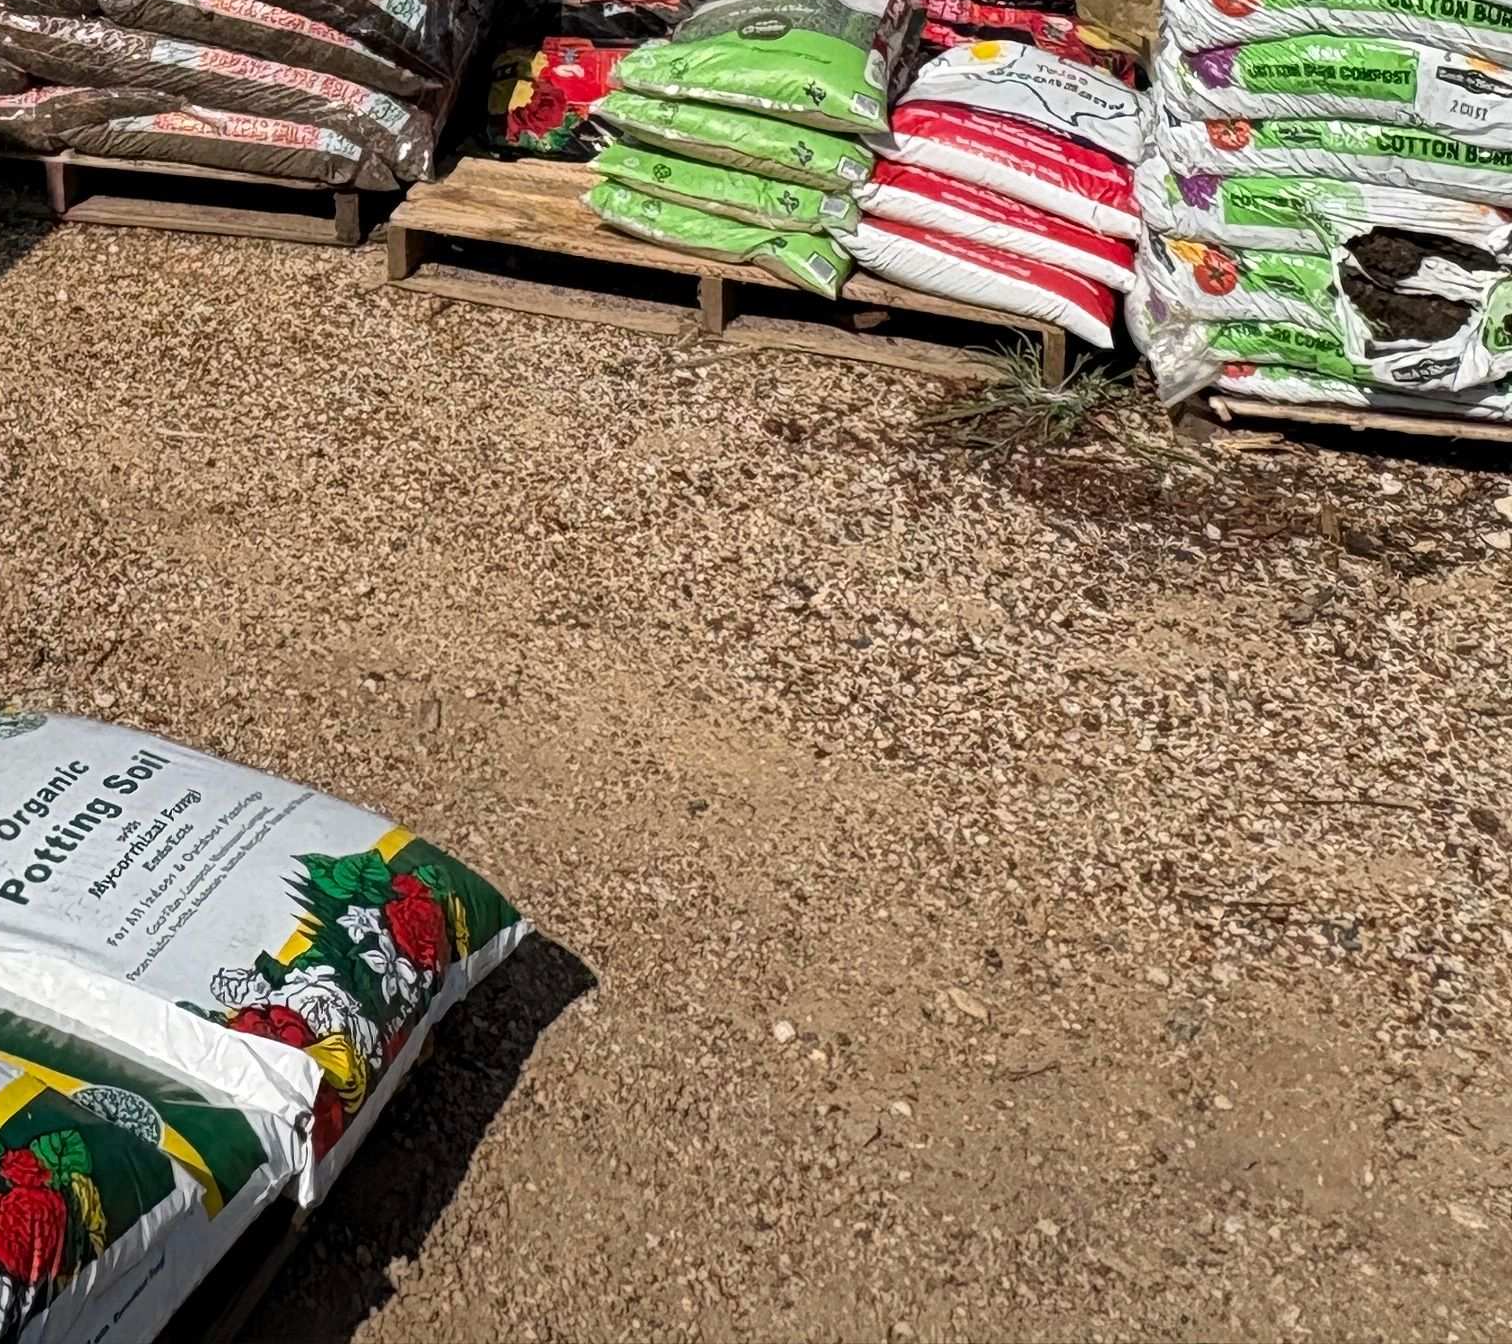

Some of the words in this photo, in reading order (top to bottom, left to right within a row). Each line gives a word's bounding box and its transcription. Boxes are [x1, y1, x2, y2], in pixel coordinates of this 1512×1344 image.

[1339, 65, 1413, 85] COMPOST
[1376, 133, 1460, 161] COTTON
[103, 748, 173, 796] Soil
[88, 812, 169, 900] Mycorrhizal
